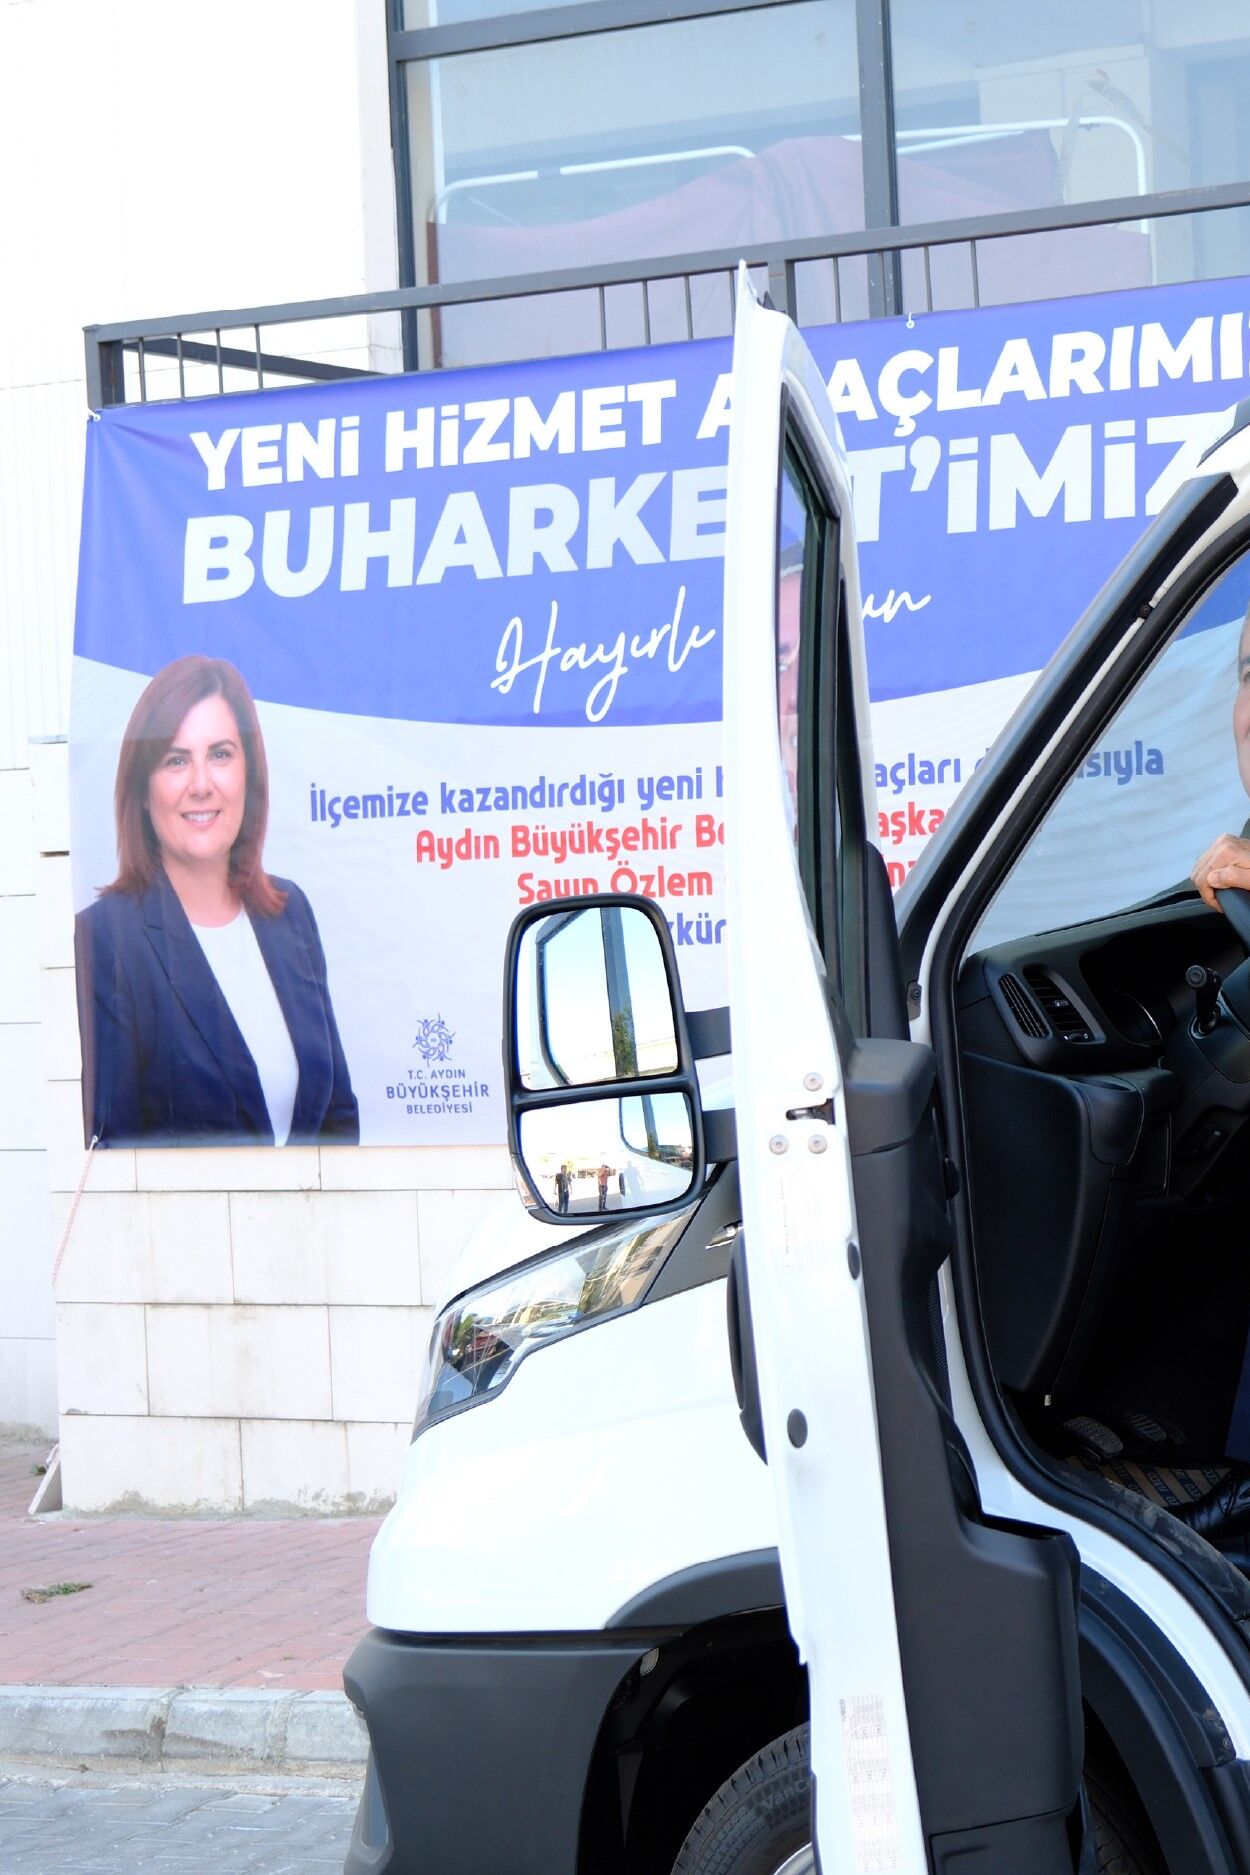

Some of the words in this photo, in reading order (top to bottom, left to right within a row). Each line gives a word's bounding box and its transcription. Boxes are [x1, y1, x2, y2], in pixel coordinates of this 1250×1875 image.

[310, 783, 429, 829] İlçemize
[440, 773, 625, 813] kazandırdığı
[637, 766, 703, 811] yeni
[416, 828, 500, 870] Aydın
[511, 816, 683, 864] Büyükşehir
[610, 860, 713, 899] Özlem
[430, 1069, 466, 1079] AYDIN
[386, 1080, 490, 1102] BÜYÜKŞEHİR
[406, 1101, 473, 1115] BELEDİYESİ
